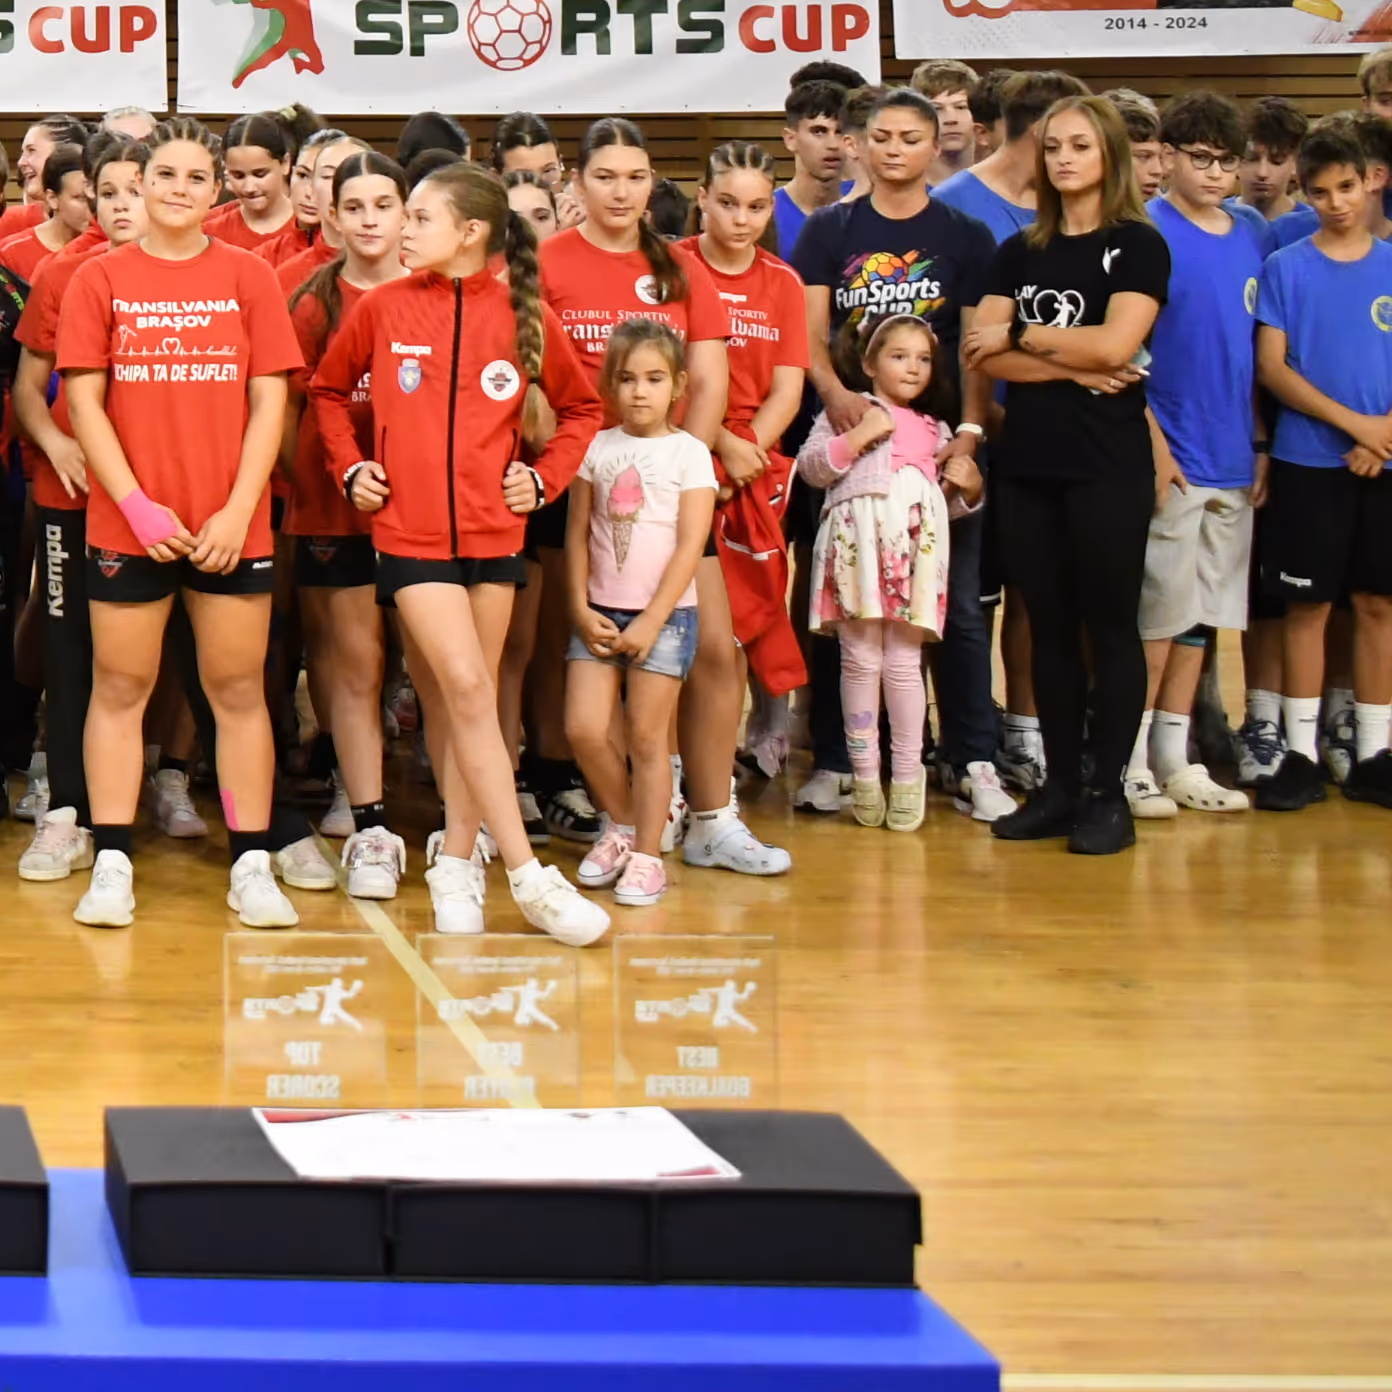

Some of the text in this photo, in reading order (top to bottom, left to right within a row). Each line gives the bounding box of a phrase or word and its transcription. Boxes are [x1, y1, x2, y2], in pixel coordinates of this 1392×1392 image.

[27, 4, 158, 54] CUP
[737, 3, 870, 53] CUP
[1104, 17, 1208, 30] 2014 2024
[112, 298, 241, 314] TRANSILVANIA
[561, 309, 612, 321] CLUBUL
[135, 314, 212, 332] BRAȘOV
[390, 340, 432, 356] Kempa
[152, 363, 238, 381] TA DE SUFLET!
[46, 523, 70, 618] Kempa
